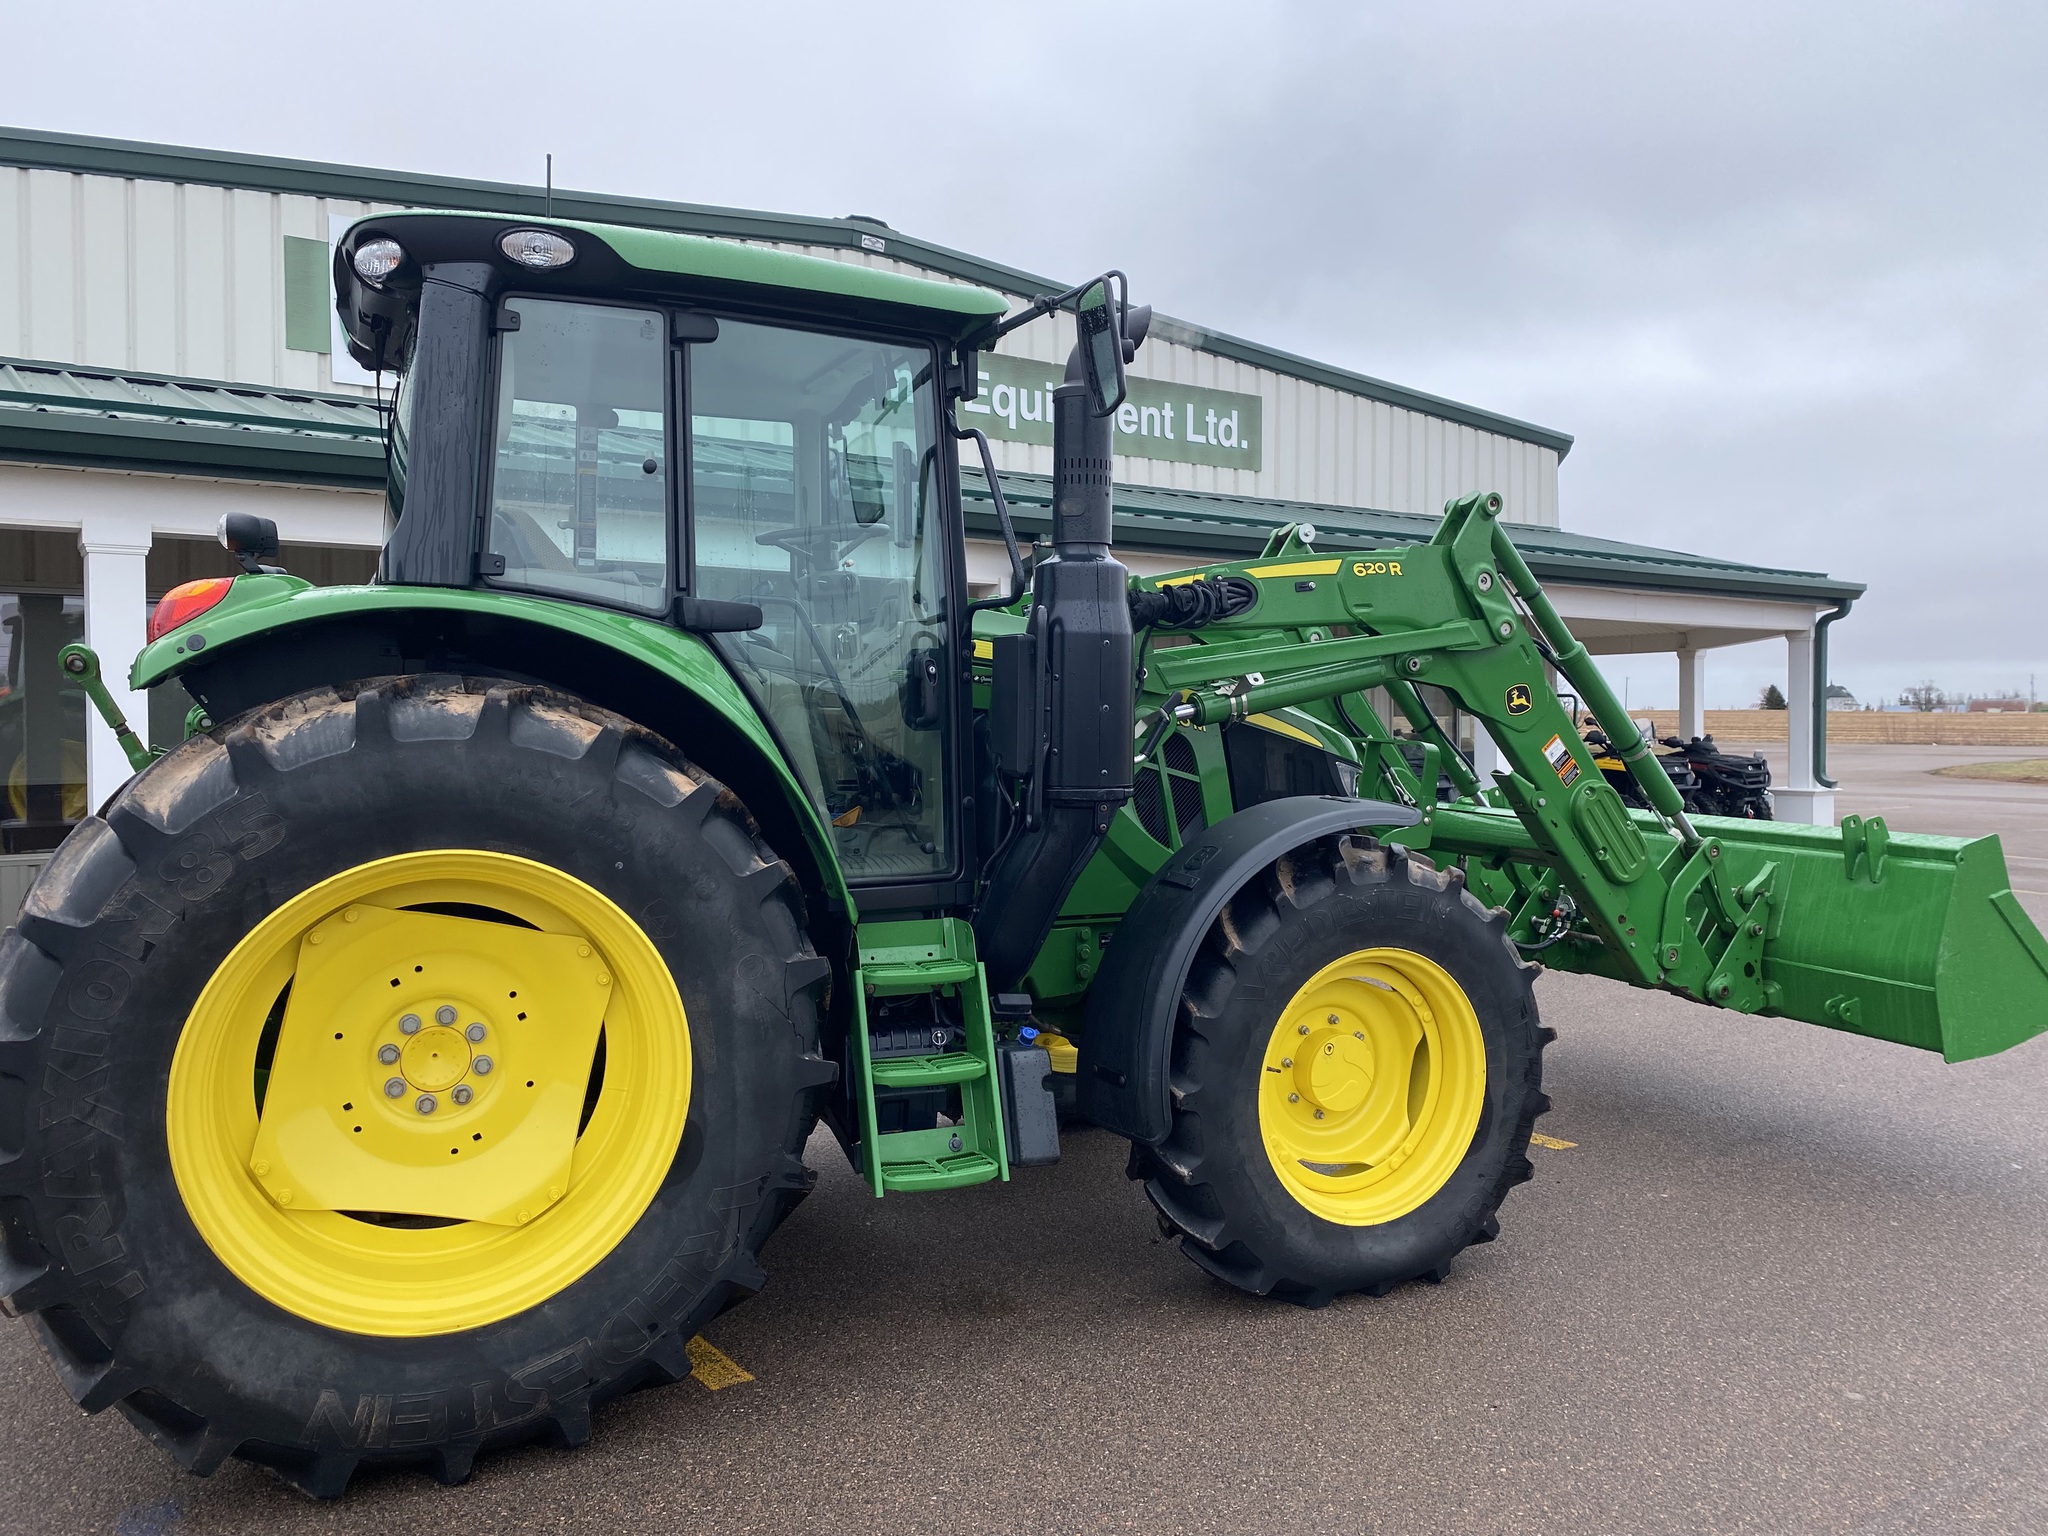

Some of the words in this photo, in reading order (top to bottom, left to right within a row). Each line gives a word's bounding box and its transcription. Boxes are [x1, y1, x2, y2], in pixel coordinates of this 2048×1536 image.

[965, 371, 1174, 440] Equient
[1186, 403, 1248, 449] Ltd.
[38, 890, 177, 1321] TRAXION
[157, 792, 287, 901] 85
[297, 1171, 771, 1449] VREDESTEIN
